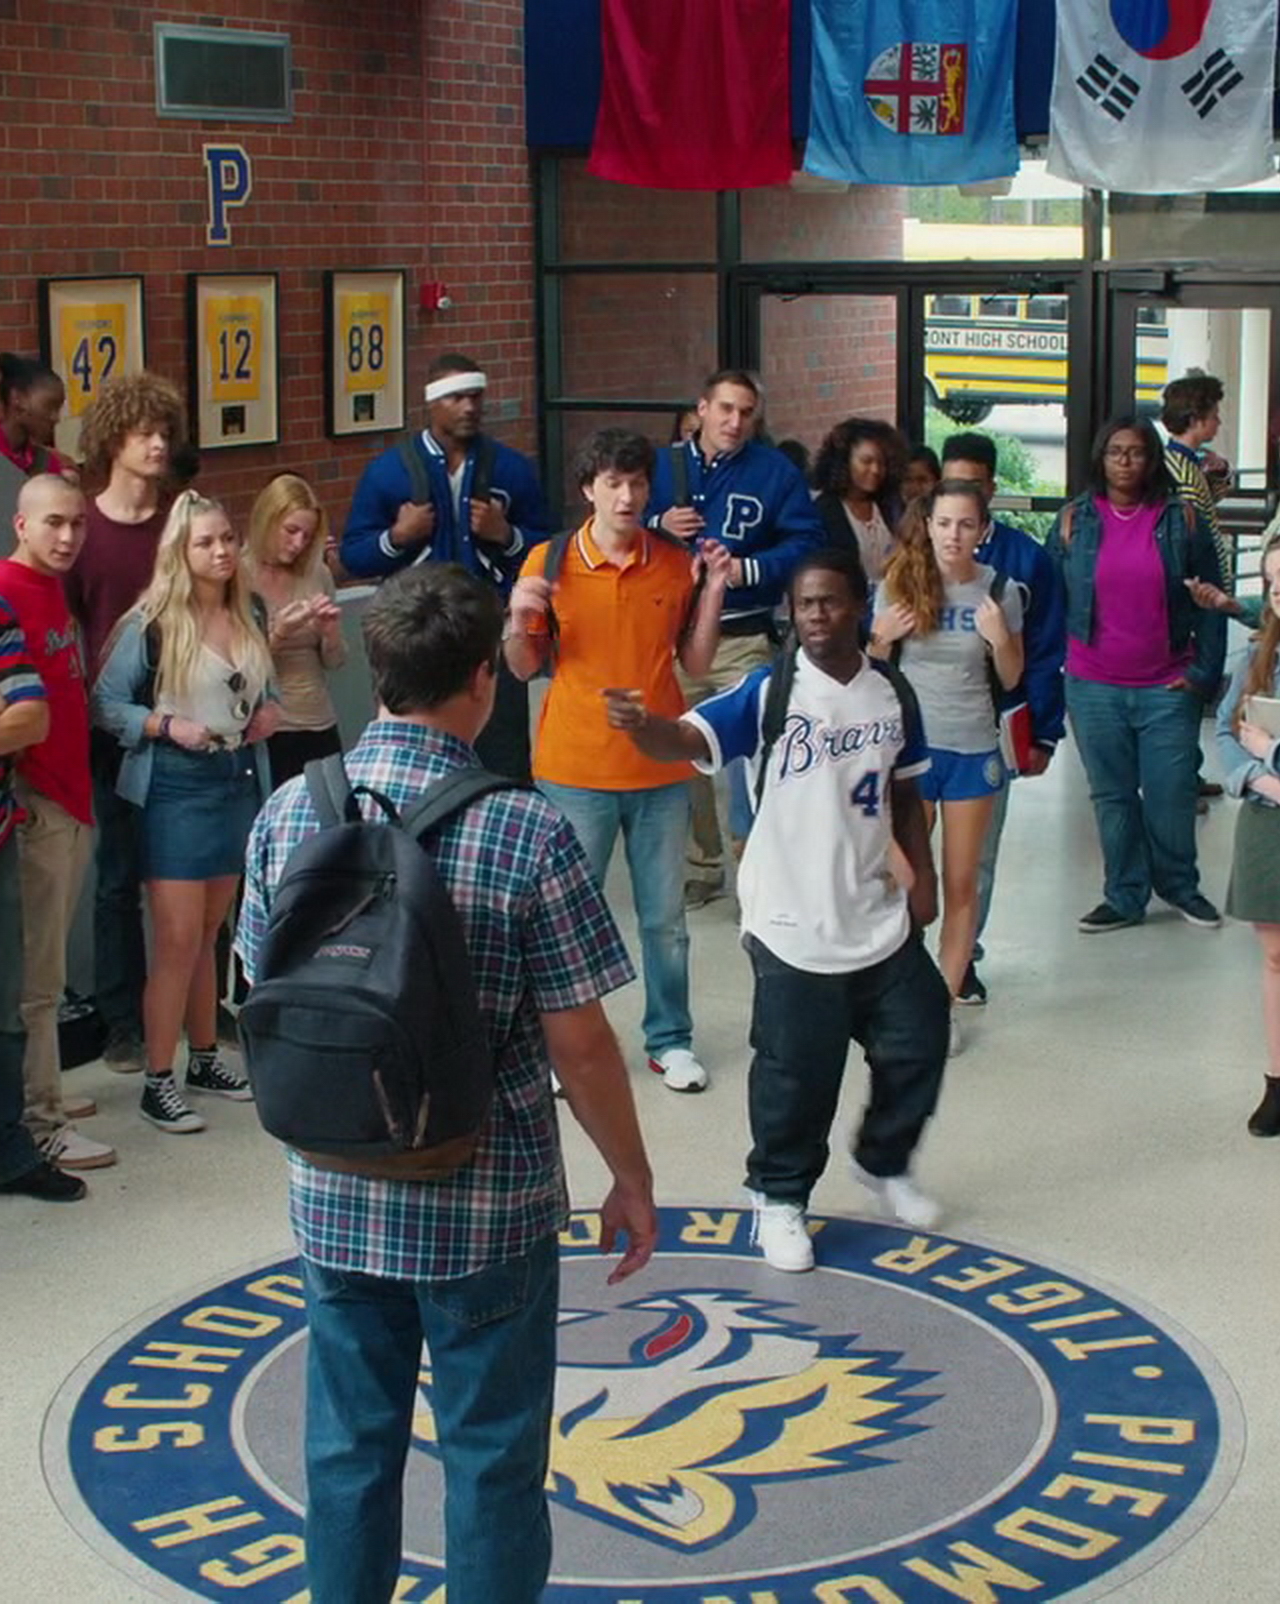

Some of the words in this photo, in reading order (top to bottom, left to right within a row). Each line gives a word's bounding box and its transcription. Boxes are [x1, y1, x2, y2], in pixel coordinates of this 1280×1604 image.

[202, 144, 252, 247] P
[219, 329, 252, 381] 12
[348, 324, 383, 373] 88
[965, 332, 1002, 348] HIGH
[1006, 333, 1068, 351] SCHOOL
[722, 493, 763, 540] P
[939, 607, 977, 632] HS
[871, 1235, 1159, 1361] TIGER
[92, 1273, 307, 1454] SCHOO
